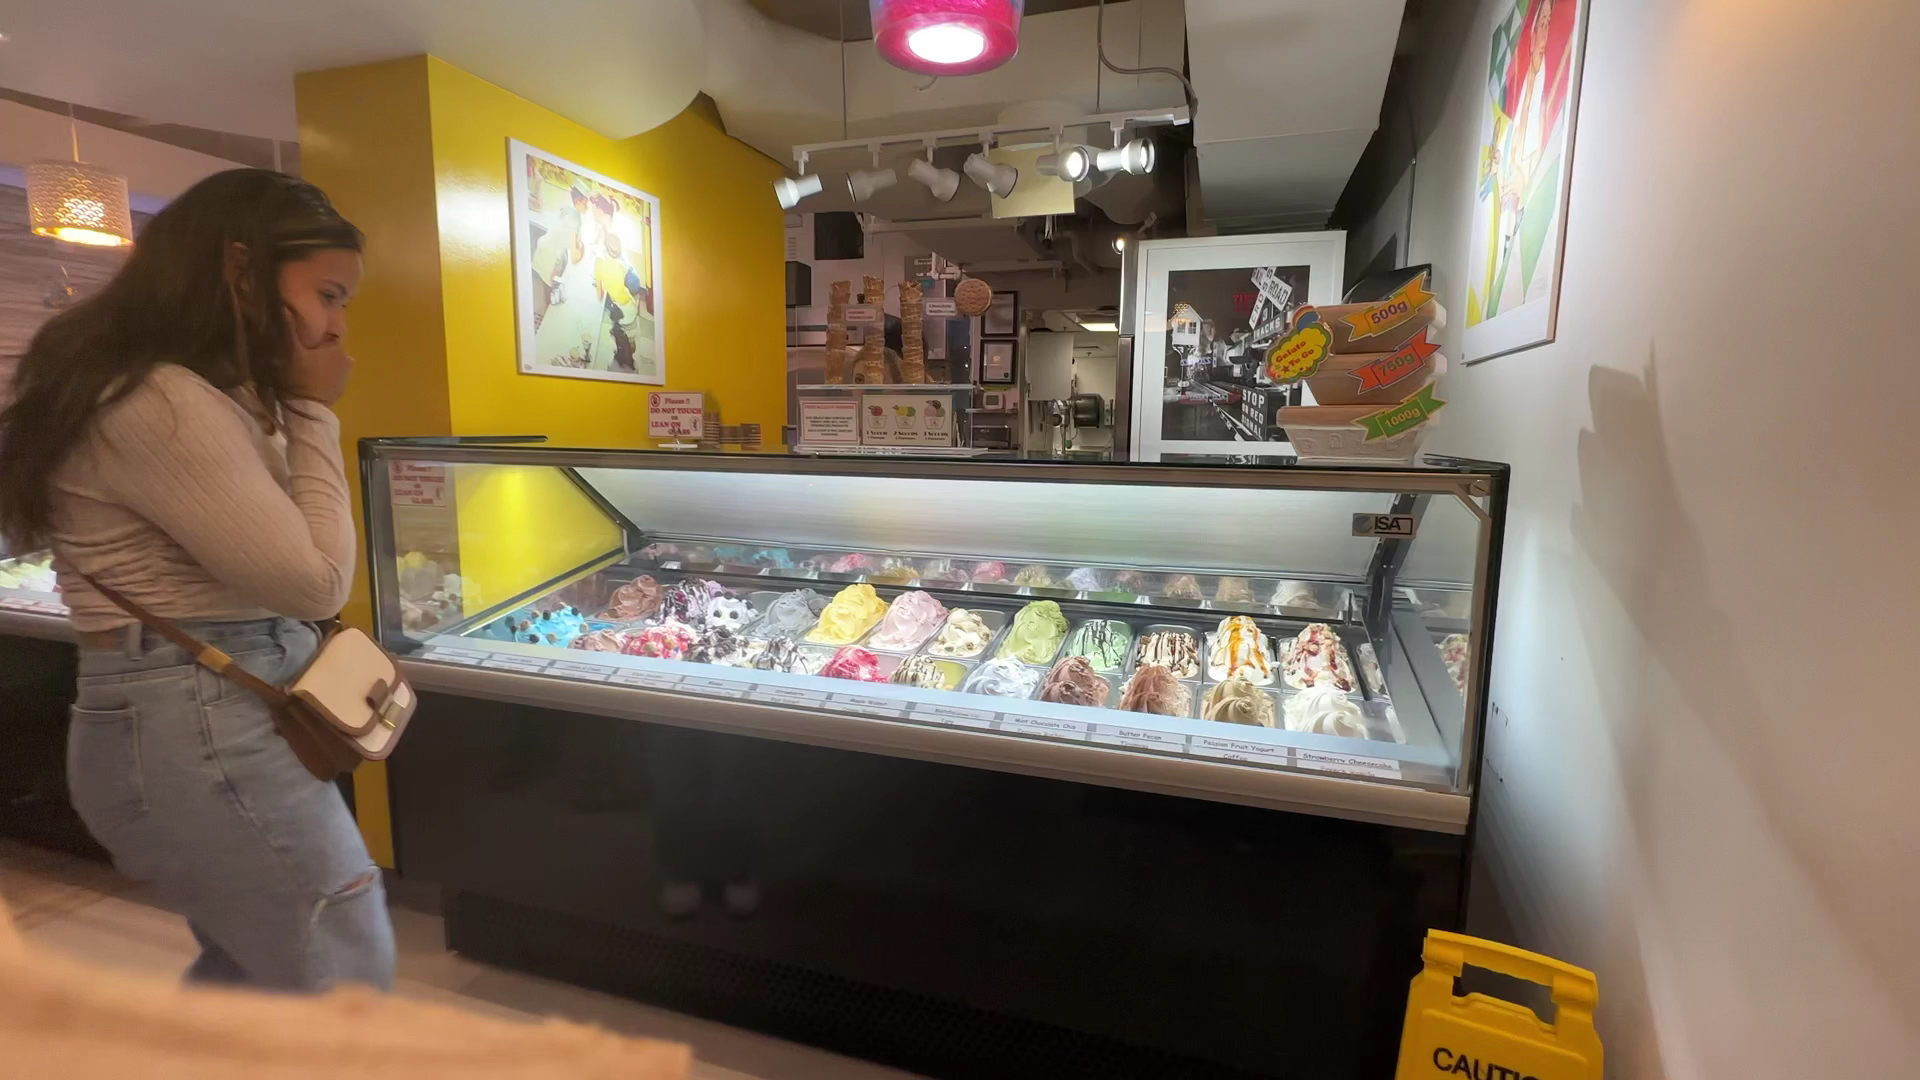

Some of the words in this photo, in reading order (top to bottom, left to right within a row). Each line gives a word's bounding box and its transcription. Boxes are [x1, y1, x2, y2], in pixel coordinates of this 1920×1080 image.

[1267, 280, 1289, 306] ROAD
[1371, 300, 1408, 324] 500g
[1276, 341, 1307, 363] Gelato
[1301, 349, 1314, 359] Go
[1379, 353, 1416, 377] 750g
[1242, 388, 1265, 409] STOP
[677, 407, 702, 415] TOUCH
[1250, 408, 1264, 425] RED
[1385, 407, 1420, 429] 1000g
[1374, 516, 1401, 531] ISA
[1030, 719, 1060, 728] Chocolate
[1119, 730, 1141, 738] Butter
[1142, 733, 1162, 741] Pecan
[1203, 739, 1229, 748] Passion
[1230, 742, 1248, 750] Fruit
[1250, 745, 1275, 754] Yogurt
[1223, 753, 1248, 762] Coffee
[1303, 752, 1345, 764] Strawberry
[1348, 758, 1394, 769] Cheesecake
